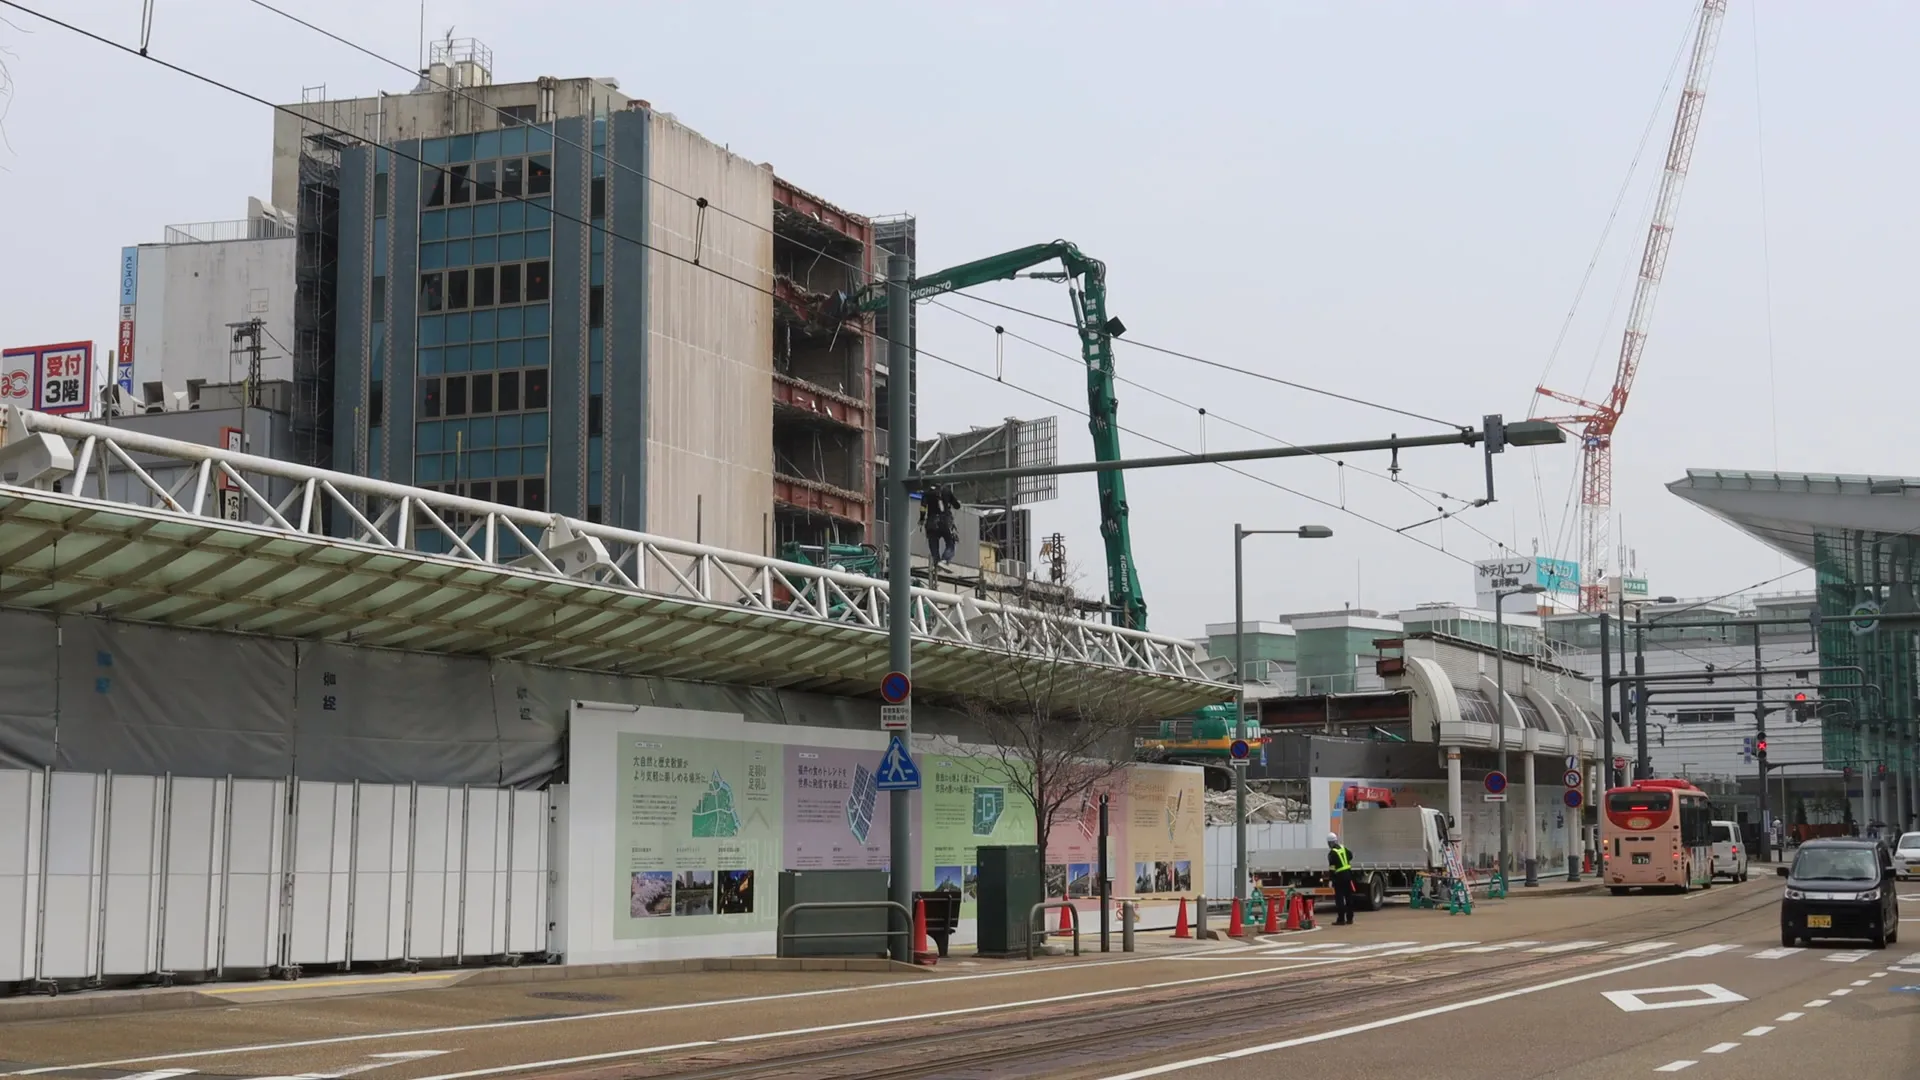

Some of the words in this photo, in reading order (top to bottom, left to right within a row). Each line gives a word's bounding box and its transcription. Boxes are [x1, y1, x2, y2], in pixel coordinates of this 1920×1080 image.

[124, 256, 132, 296] KUMON
[46, 354, 82, 378] 受付
[45, 378, 79, 404] 3階
